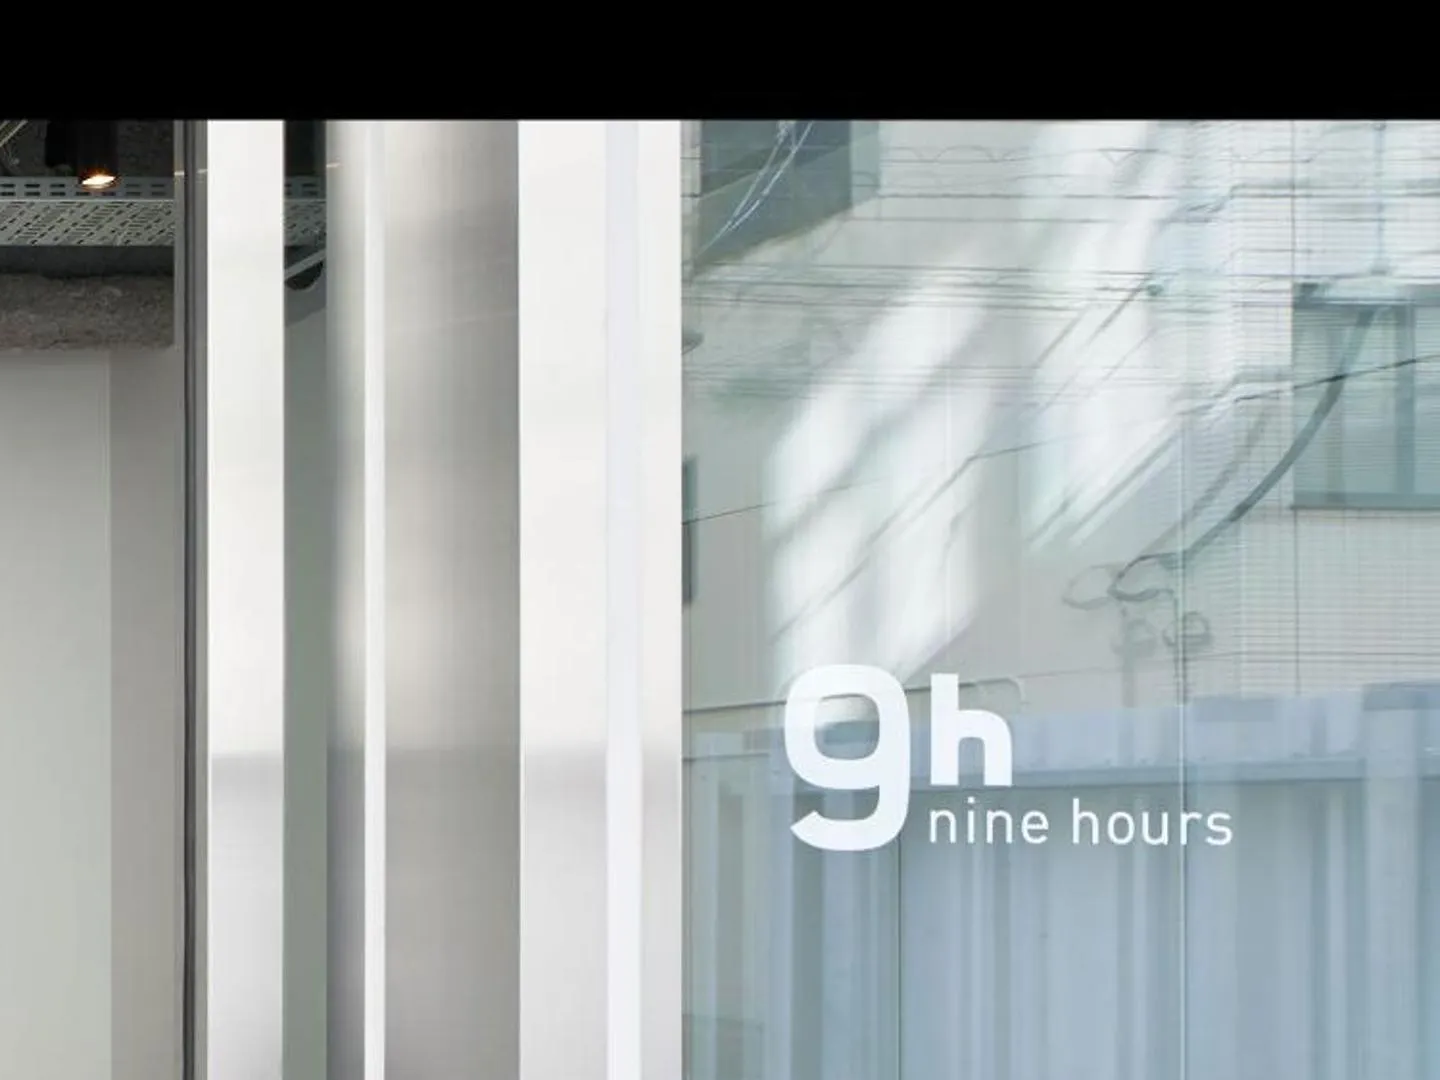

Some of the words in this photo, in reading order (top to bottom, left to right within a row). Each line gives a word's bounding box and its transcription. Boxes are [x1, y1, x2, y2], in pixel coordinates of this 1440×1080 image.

[785, 663, 1013, 851] 9h
[929, 797, 1050, 845] nine
[1072, 798, 1234, 846] hours
